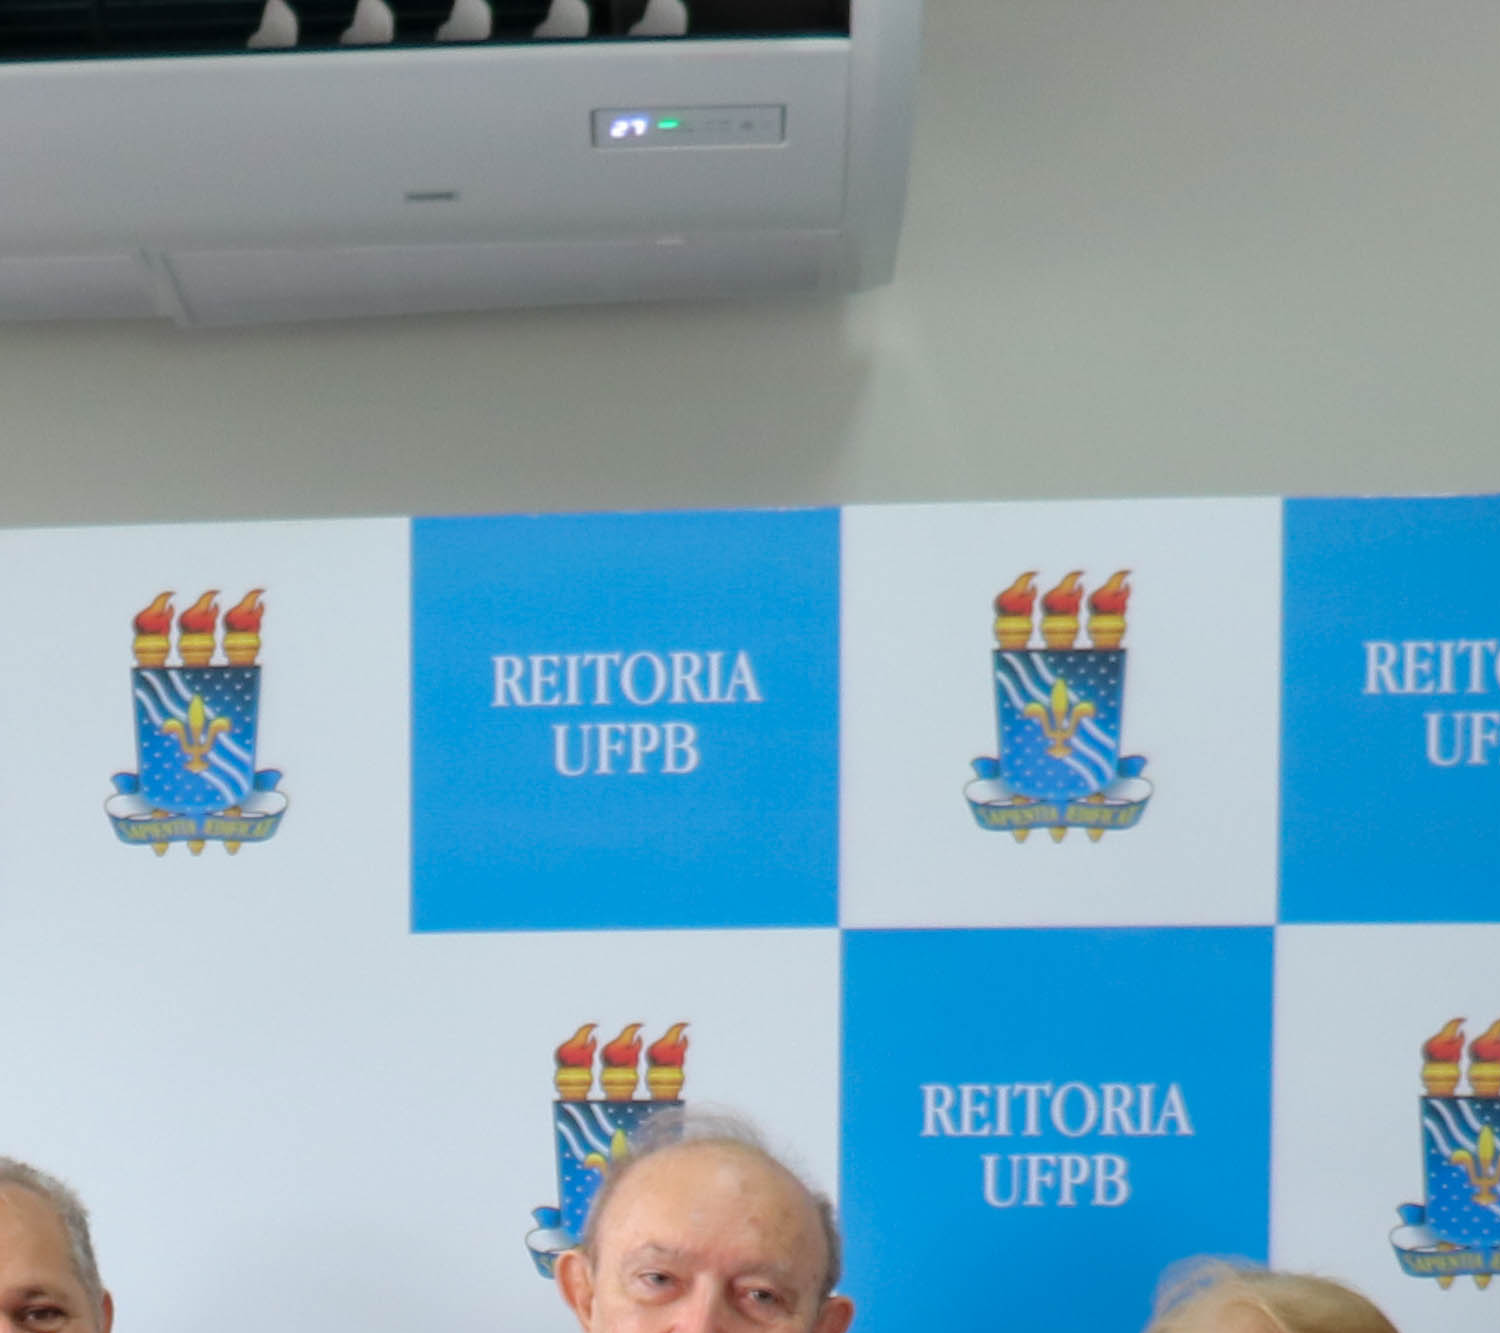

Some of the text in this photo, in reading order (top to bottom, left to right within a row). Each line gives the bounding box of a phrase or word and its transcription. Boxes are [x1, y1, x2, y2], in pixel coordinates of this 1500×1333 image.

[491, 650, 764, 707] REITORIA
[551, 721, 701, 777] UFPB
[920, 1082, 1194, 1138] REITORIA
[981, 1153, 1130, 1209] UFPB
